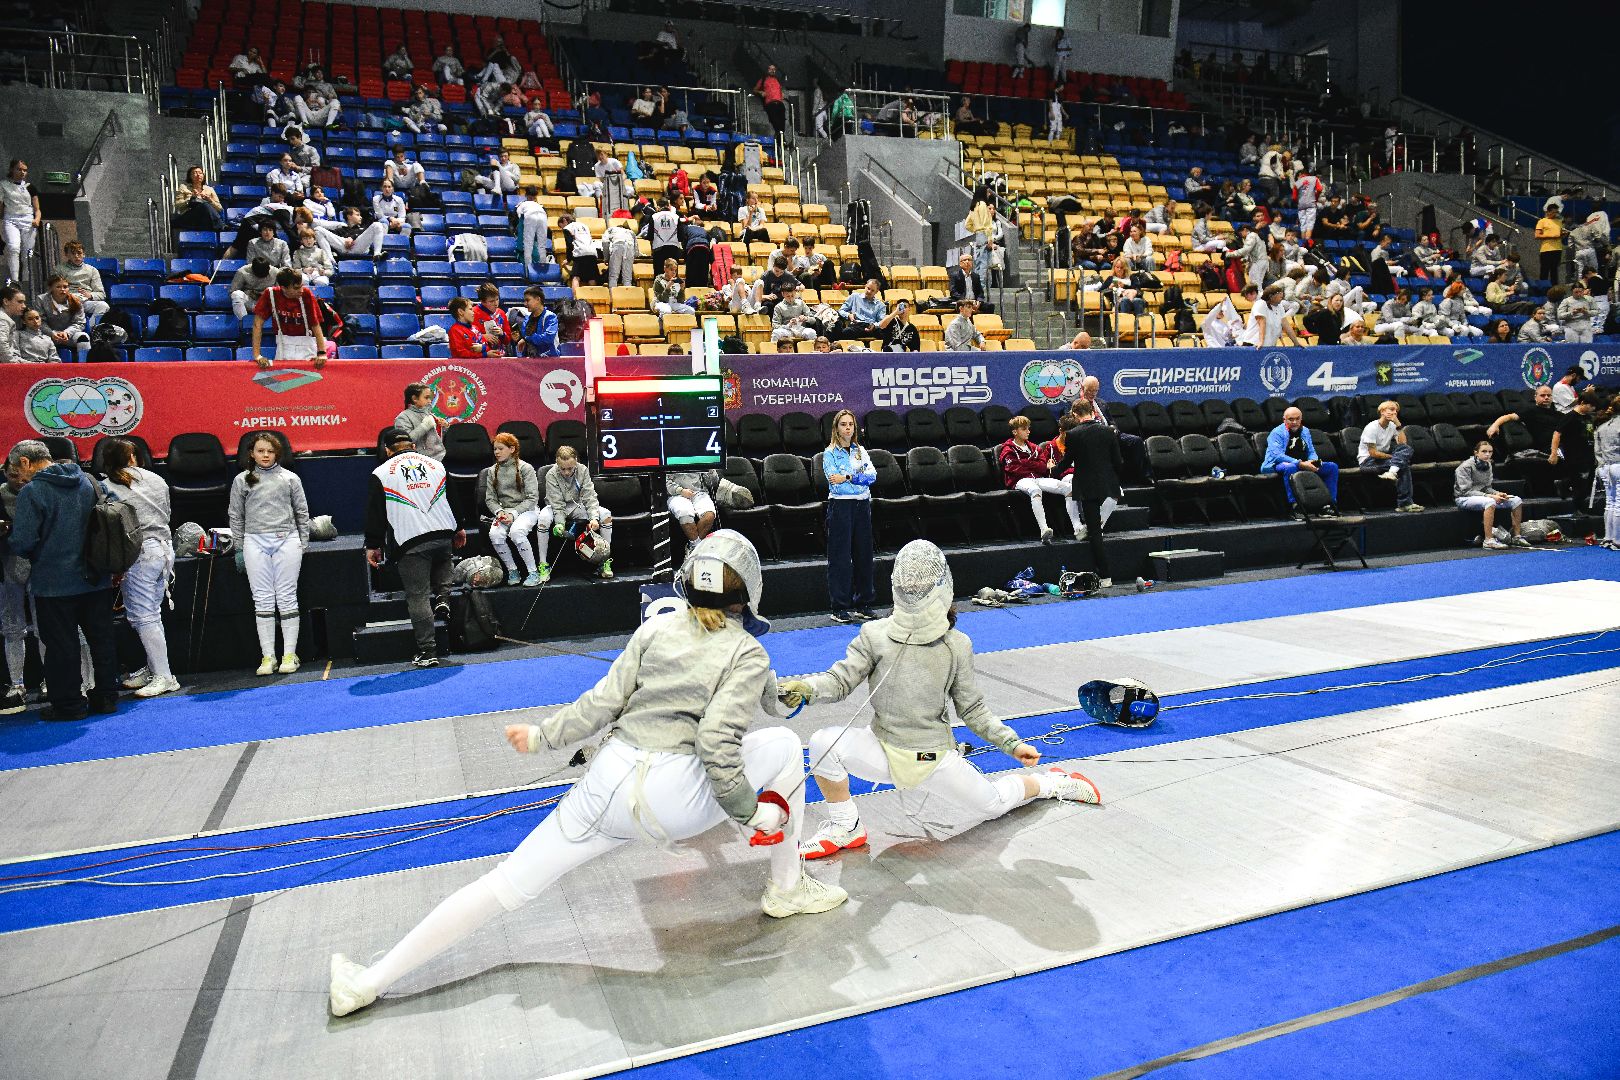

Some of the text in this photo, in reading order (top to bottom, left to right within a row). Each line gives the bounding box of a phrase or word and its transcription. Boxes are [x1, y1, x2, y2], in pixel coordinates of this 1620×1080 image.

[448, 364, 487, 396] ФЕХТОВАНИЯ
[752, 377, 819, 389] КОМАНДА
[871, 365, 988, 386] МОСОБЛ
[1147, 366, 1242, 386] ДИРЕКЦИЯ
[1306, 361, 1359, 392] 4
[753, 392, 844, 406] ГУБЕРНАТОРА
[873, 386, 965, 407] СПОРТ
[1138, 382, 1232, 395] СПОРТМЕРОПРИЯТИЙ
[233, 414, 348, 428] «АРЕНА ХИМКИ»
[601, 434, 618, 459] 3
[705, 430, 722, 454] 4
